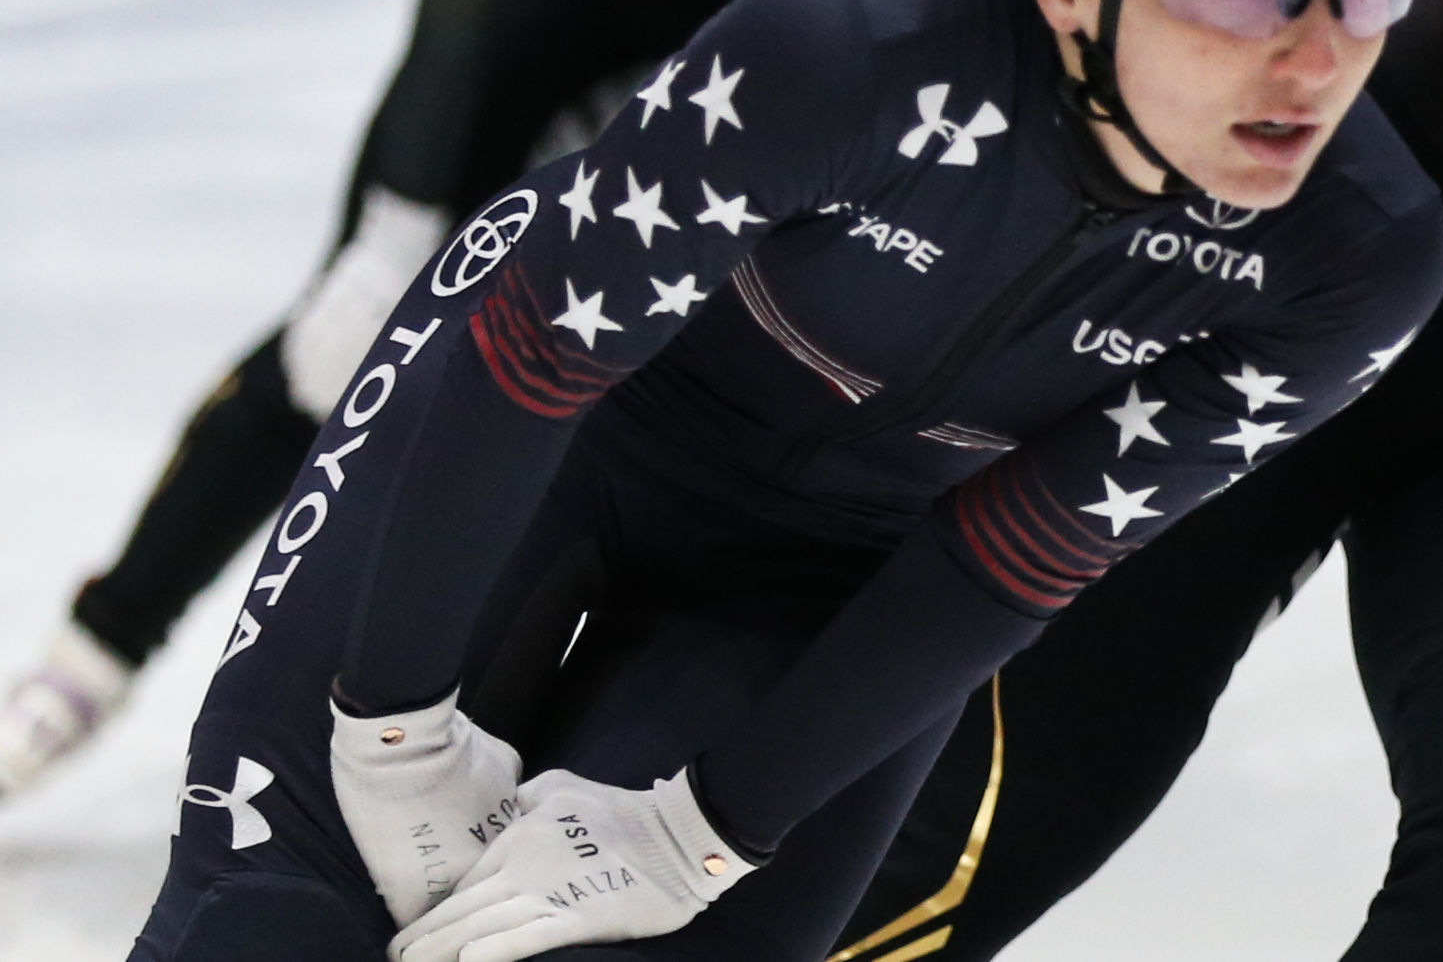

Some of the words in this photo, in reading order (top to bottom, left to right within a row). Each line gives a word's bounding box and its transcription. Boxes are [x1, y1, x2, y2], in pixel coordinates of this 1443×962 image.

[215, 317, 444, 669] TOYOTA
[557, 814, 599, 858] USA
[546, 867, 638, 910] NALZA
